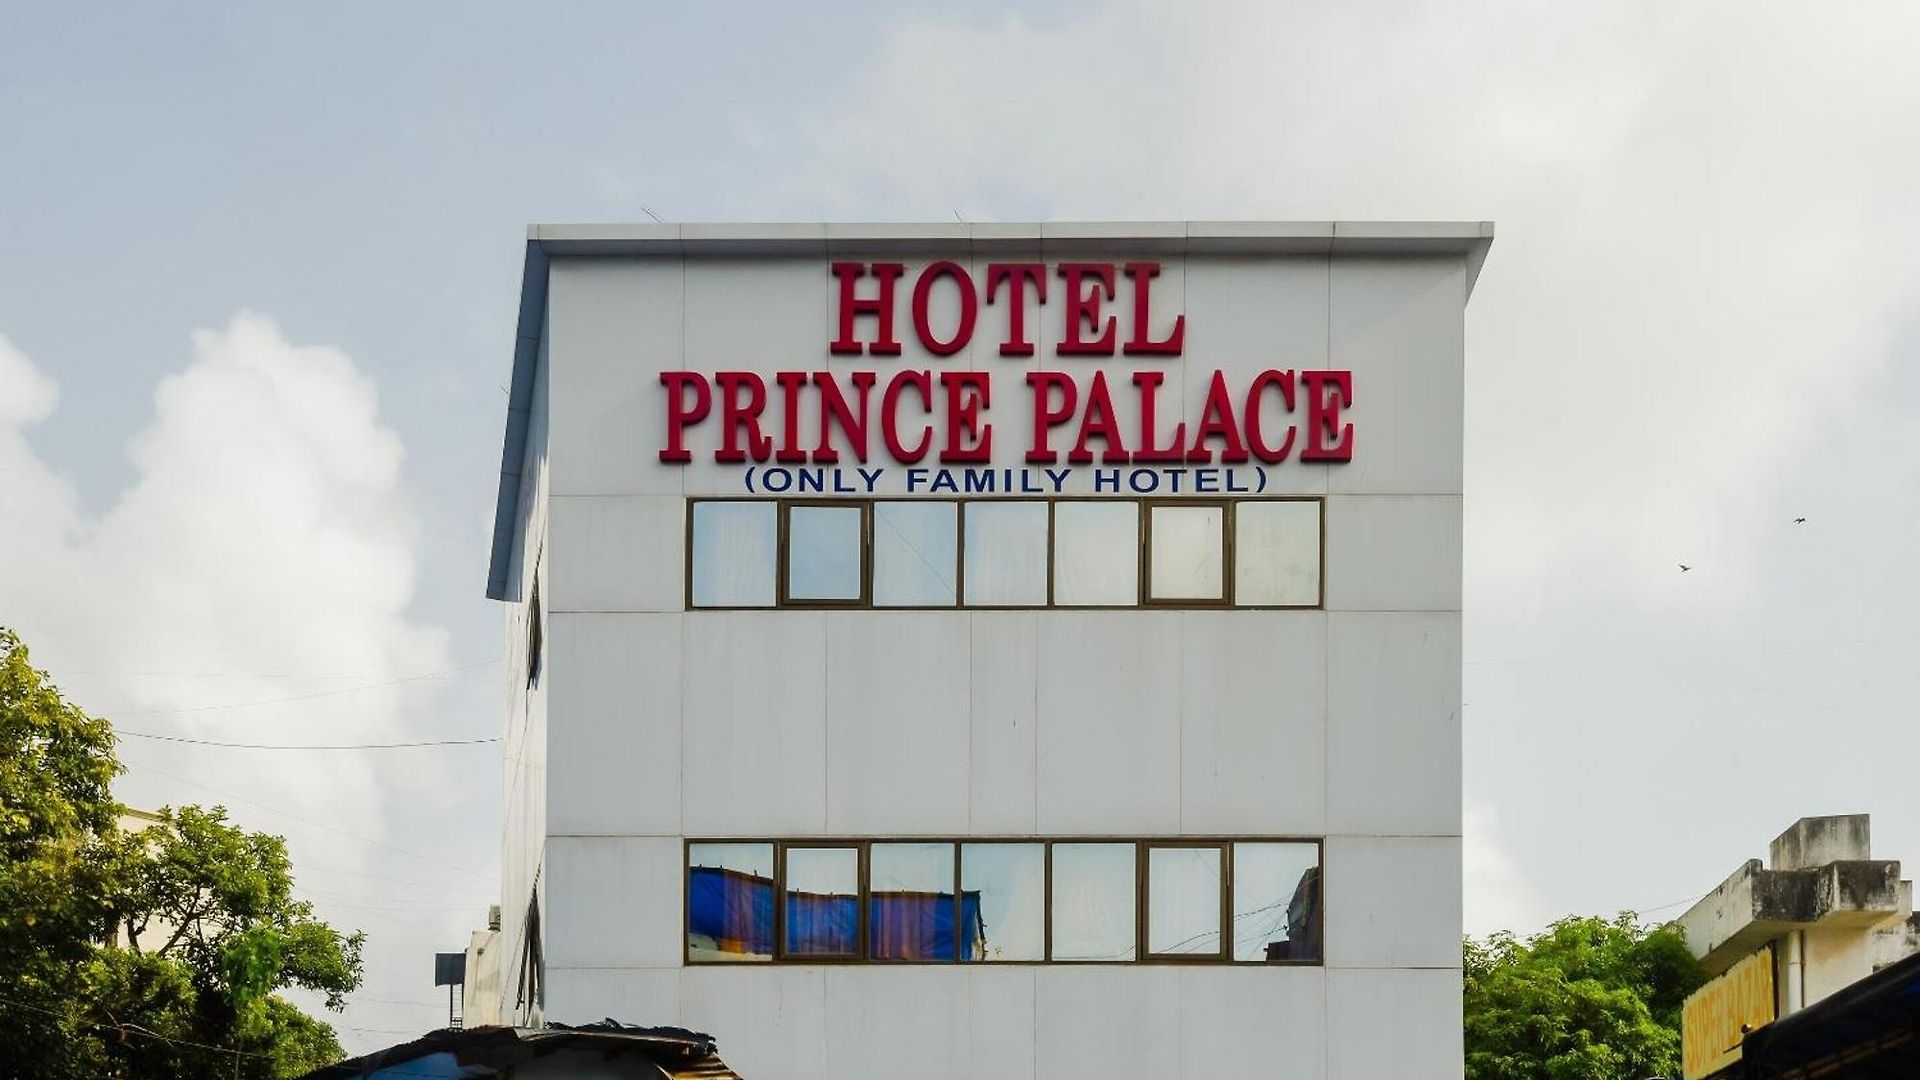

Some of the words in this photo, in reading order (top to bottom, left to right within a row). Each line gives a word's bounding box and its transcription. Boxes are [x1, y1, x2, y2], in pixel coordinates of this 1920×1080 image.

[831, 261, 1185, 356] HOTEL
[660, 370, 991, 464] PRINCE
[1026, 370, 1353, 464] PALACE
[745, 467, 884, 493] (ONLY
[907, 468, 1071, 492] FAMILY
[1095, 467, 1266, 493] HOTEL)
[1687, 985, 1722, 1073] SUPER
